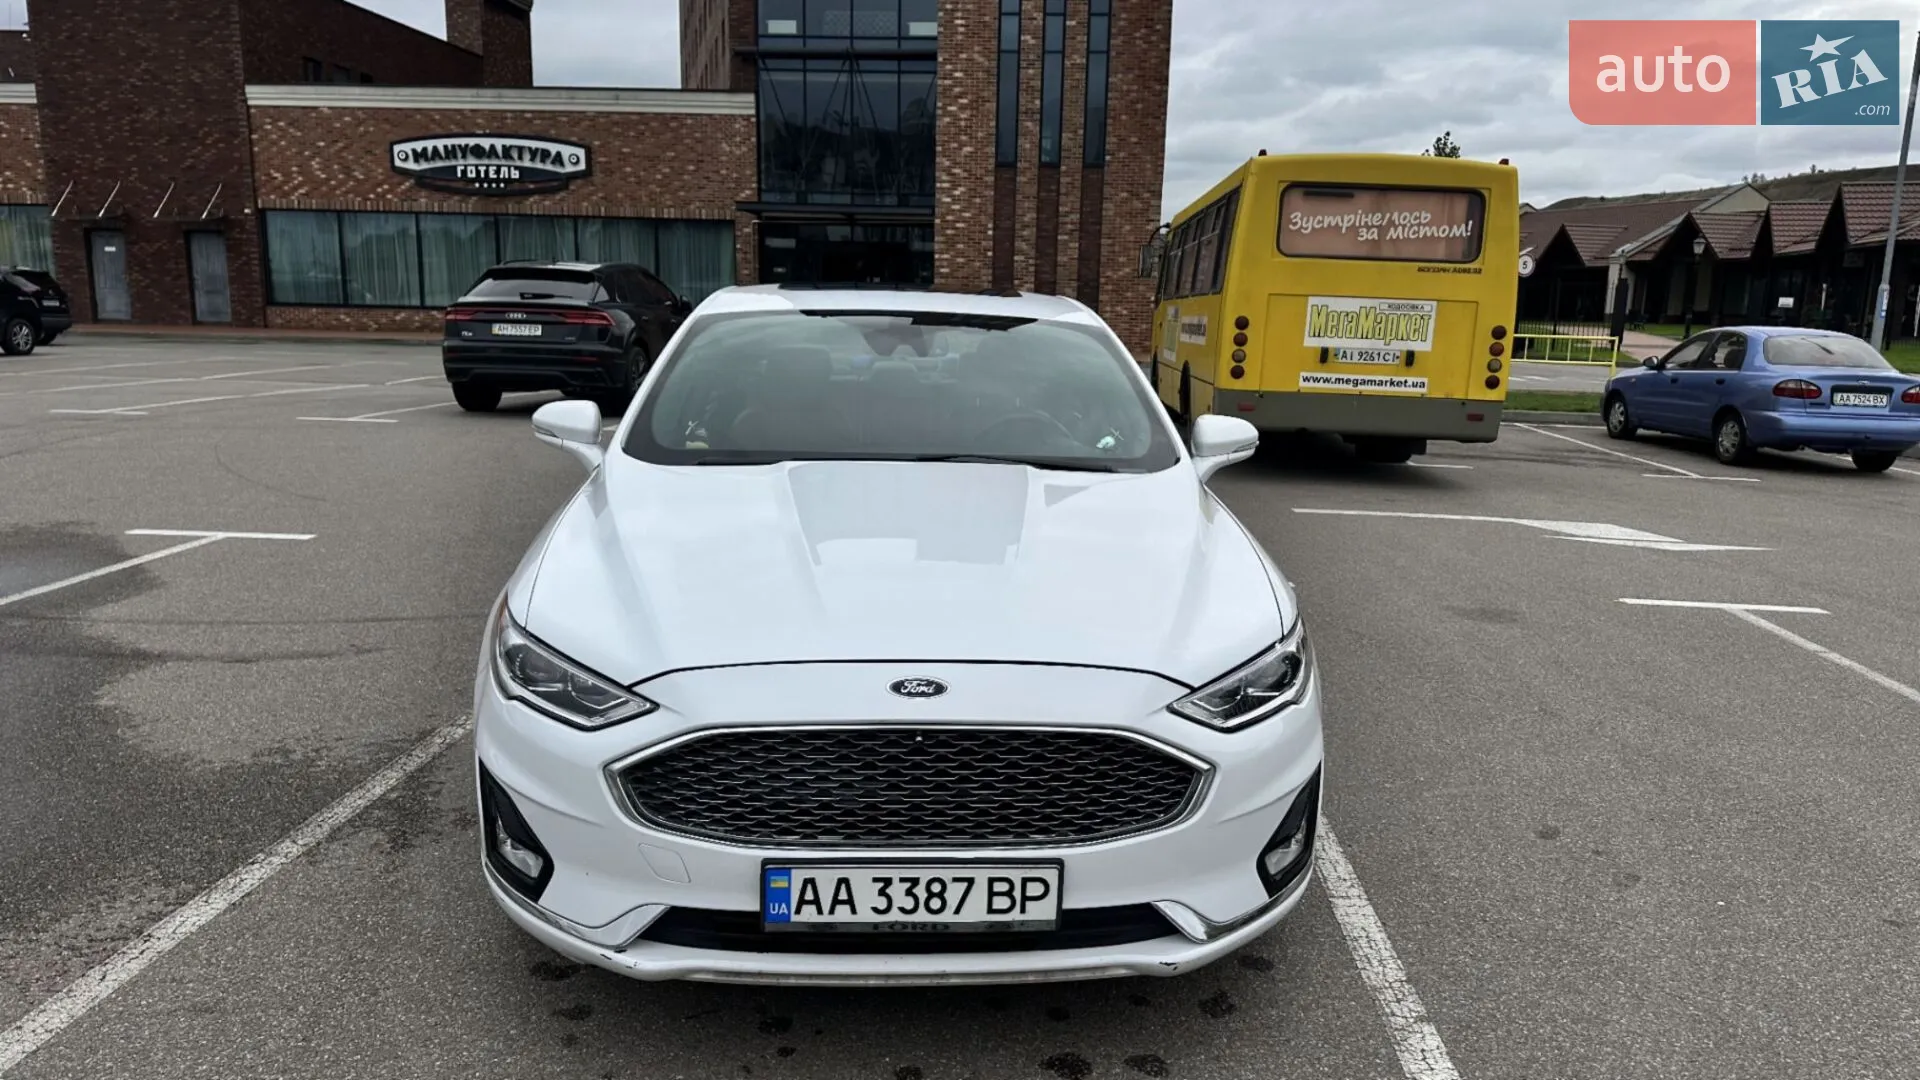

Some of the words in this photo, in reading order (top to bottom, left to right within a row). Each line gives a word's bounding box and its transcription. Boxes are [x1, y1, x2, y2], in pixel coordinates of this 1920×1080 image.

[411, 143, 566, 168] МАНУФАКТУРА
[456, 166, 520, 179] ГОТЕЛЬ
[1357, 227, 1379, 241] за
[1386, 220, 1474, 240] містом!
[1522, 260, 1528, 270] 5
[1308, 304, 1432, 345] МегаМаркет
[1357, 351, 1381, 362] 9261
[1302, 373, 1426, 389] www.megamarket.ua
[1838, 394, 1851, 404] AA
[1852, 394, 1872, 404] 7524
[1873, 395, 1885, 405] BX
[901, 680, 936, 693] Ford
[794, 876, 858, 915] AA
[870, 876, 975, 915] 3387
[986, 876, 1050, 915] BP
[769, 903, 788, 914] UA
